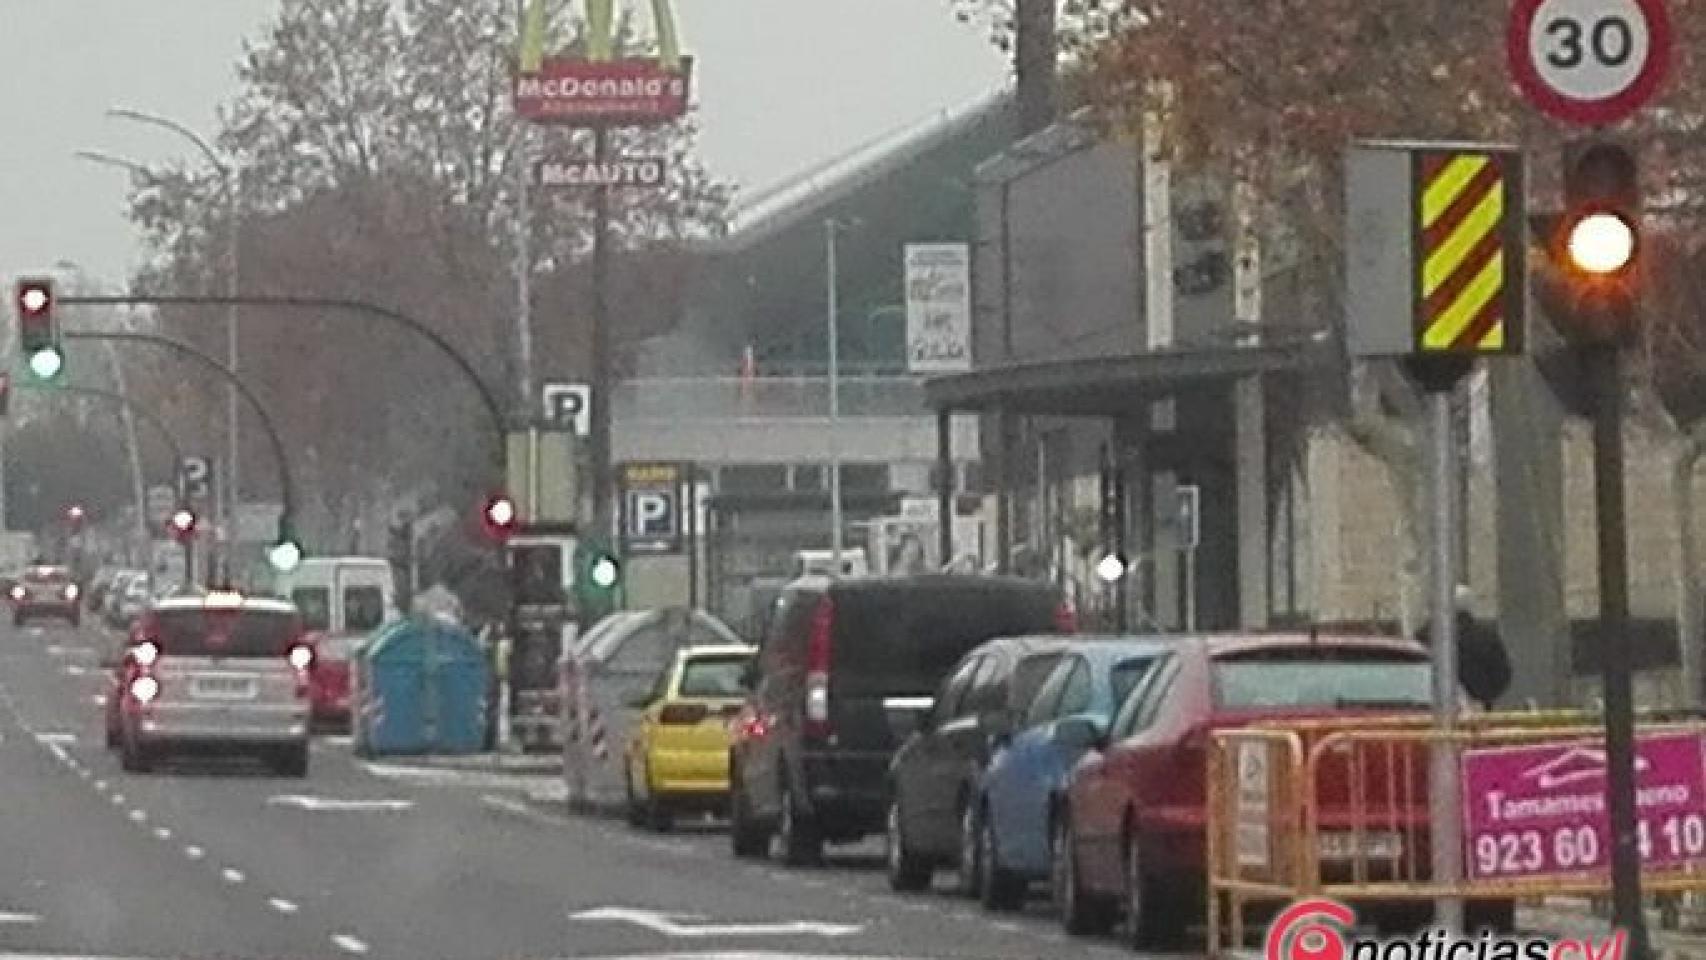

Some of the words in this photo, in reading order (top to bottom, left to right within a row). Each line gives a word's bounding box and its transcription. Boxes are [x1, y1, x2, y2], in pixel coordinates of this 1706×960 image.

[1545, 16, 1632, 68] 30
[517, 77, 684, 97] McDonald's
[541, 161, 659, 184] McAUTO
[637, 494, 667, 537] P
[1476, 830, 1543, 874] 923
[1553, 825, 1599, 866] 60
[1663, 814, 1704, 856] 10
